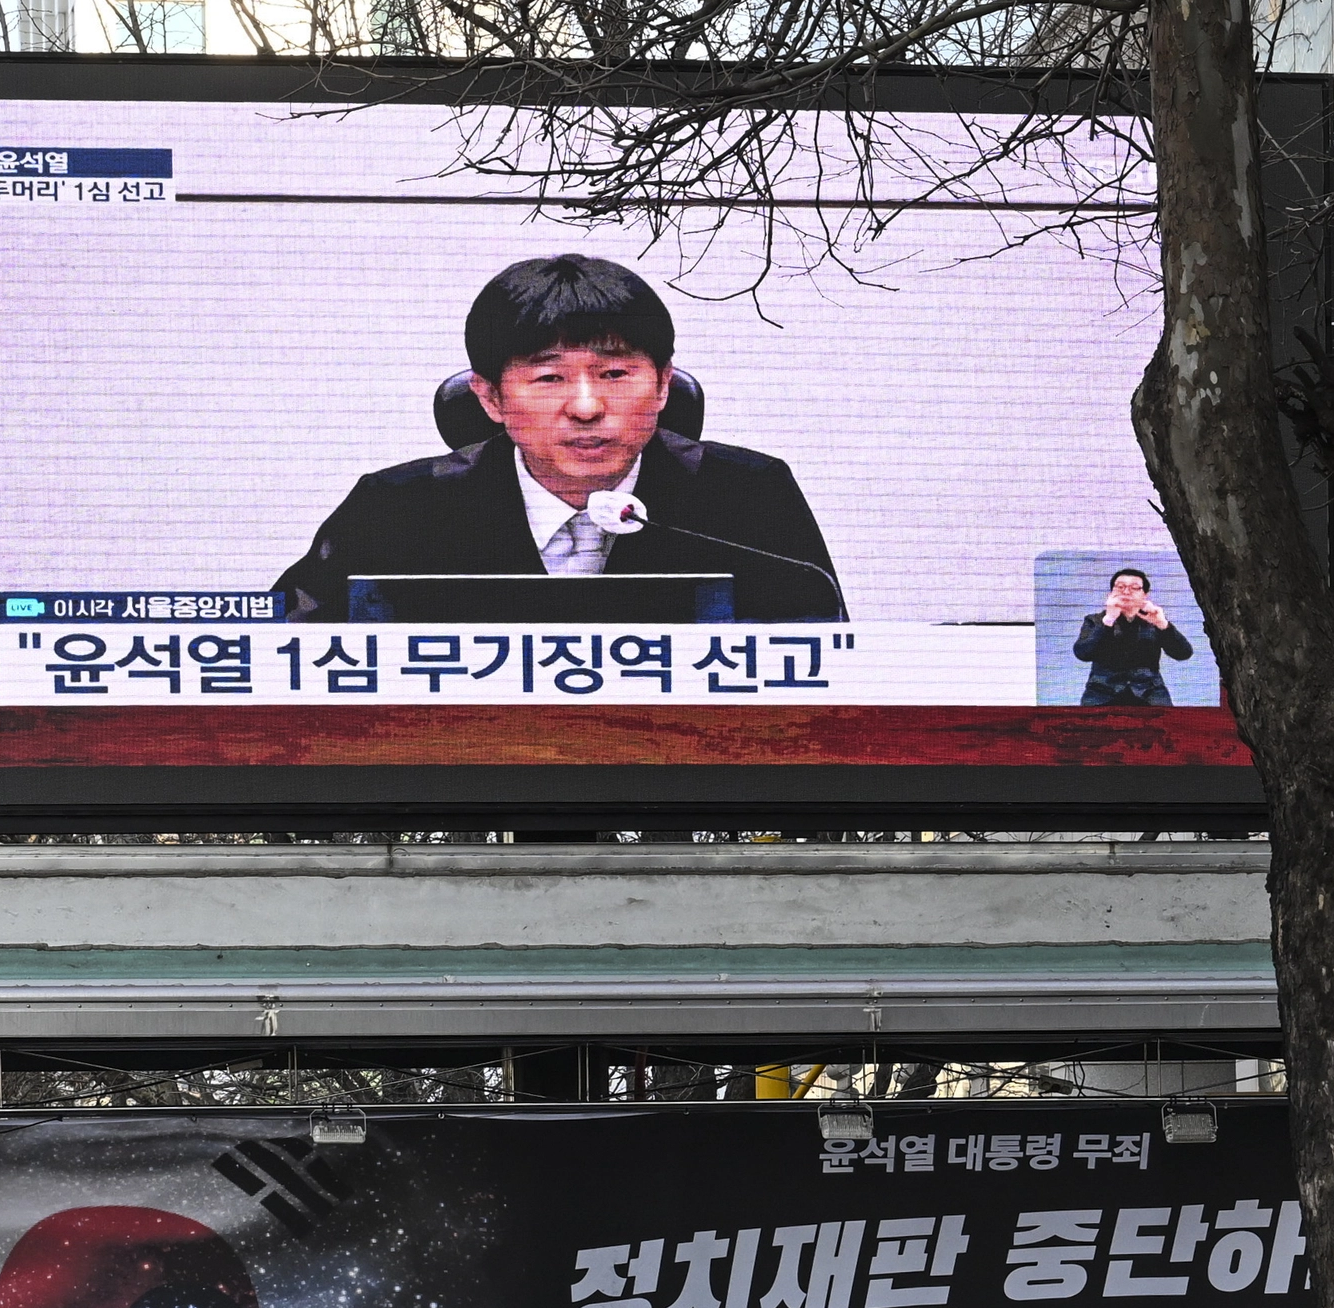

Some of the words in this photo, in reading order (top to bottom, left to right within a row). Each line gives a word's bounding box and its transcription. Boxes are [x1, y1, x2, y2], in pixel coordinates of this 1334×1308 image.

[75, 182, 110, 202] 1심
[118, 182, 166, 203] 선고
[11, 604, 33, 612] LIVE
[54, 599, 115, 617] 이시각
[122, 597, 274, 618] 서울중앙지법
[18, 632, 253, 695] "윤석열
[276, 635, 378, 694] 1심
[400, 634, 672, 695] 무기징역
[693, 633, 856, 693] 선고"
[819, 1134, 936, 1174] 윤석열
[948, 1133, 1062, 1171] 대통령
[1073, 1132, 1151, 1170] 무죄
[1003, 1199, 1313, 1300] 중단하
